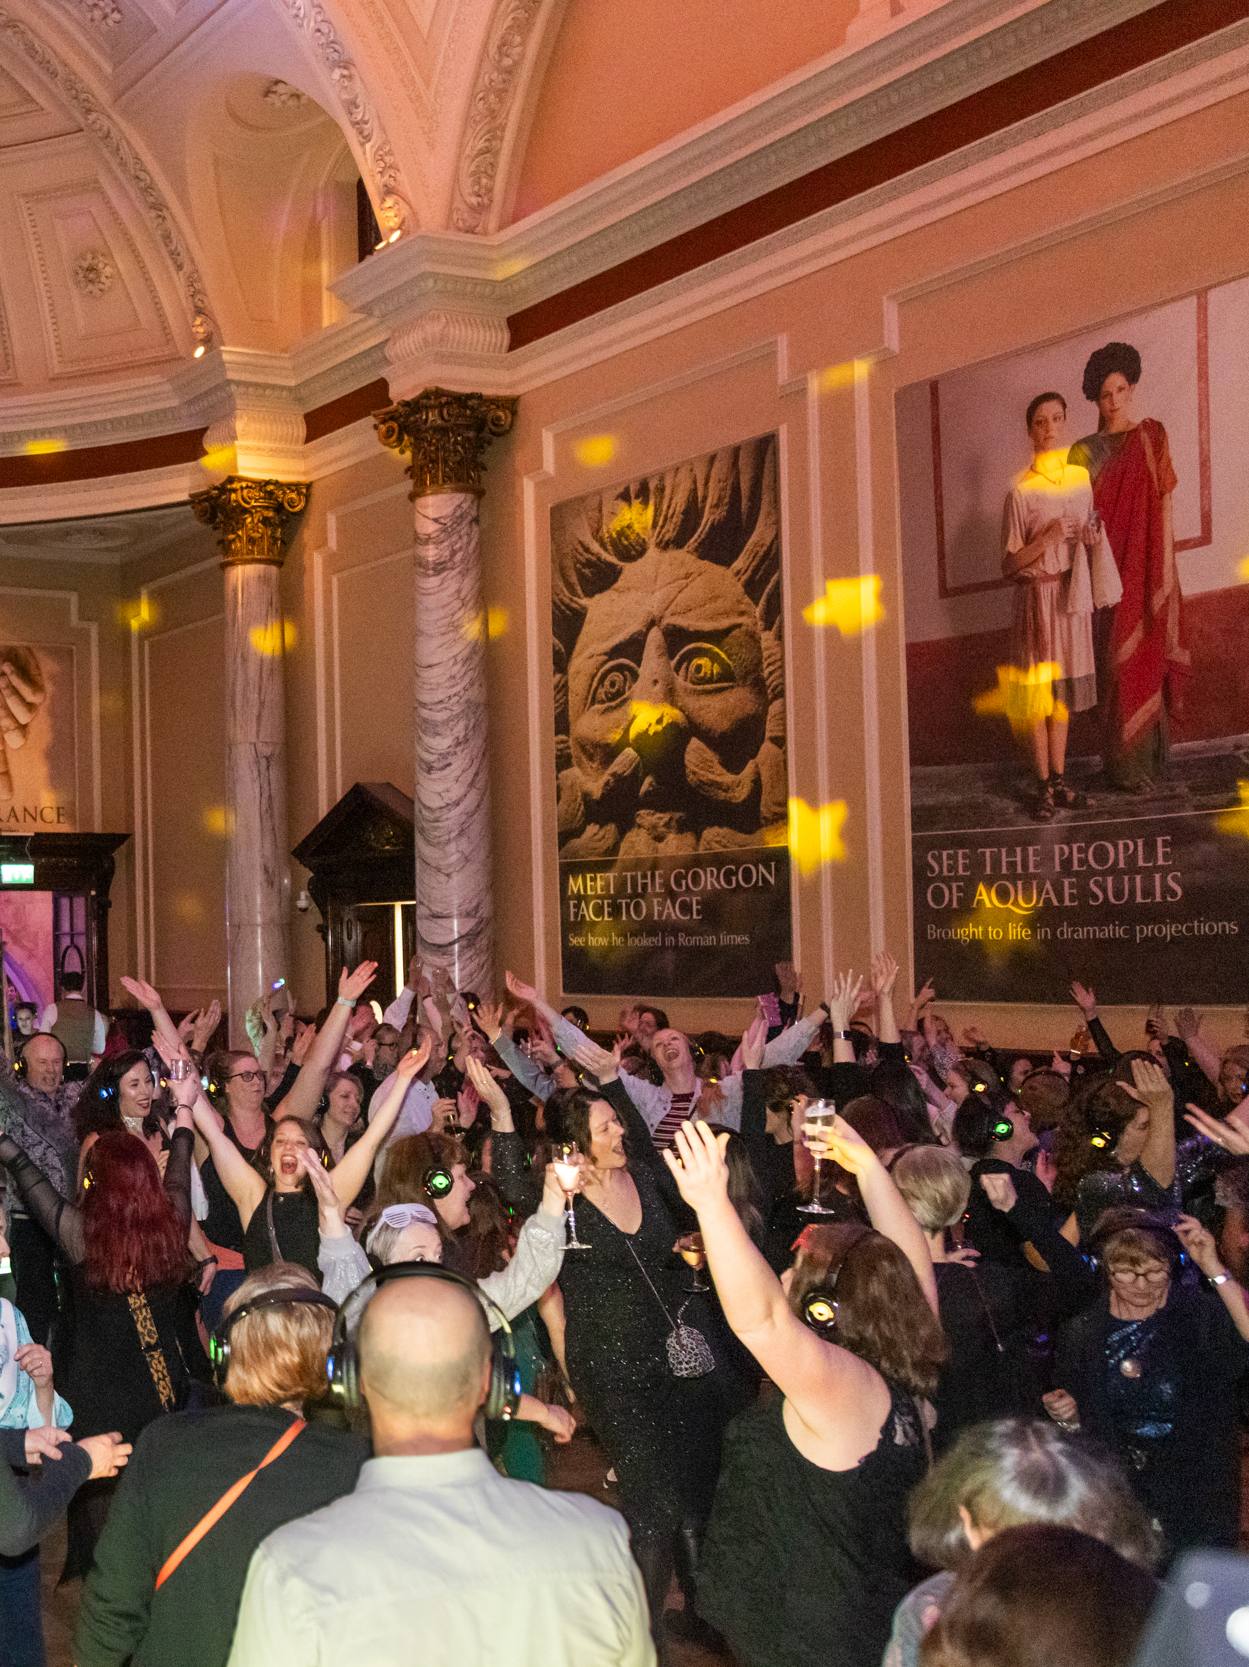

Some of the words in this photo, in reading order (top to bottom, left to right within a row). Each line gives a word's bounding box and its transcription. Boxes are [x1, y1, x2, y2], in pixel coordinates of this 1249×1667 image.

[927, 849, 971, 877] SEE
[977, 845, 1042, 875] THE
[1053, 836, 1173, 872] PEOPLE
[568, 872, 619, 896] MEET
[622, 870, 665, 893] THE
[670, 861, 776, 893] GORGON
[927, 882, 965, 909] OF
[973, 878, 1078, 915] AQUAE
[1089, 871, 1183, 906] SULIS
[569, 899, 613, 922] FACE
[617, 898, 646, 921] TO
[653, 896, 703, 921] FACE
[568, 933, 586, 947] See
[588, 933, 611, 947] how
[611, 932, 625, 947] he
[627, 932, 662, 947] looked
[665, 932, 675, 947] in
[678, 932, 716, 947] Roman
[720, 931, 750, 946] times
[927, 922, 983, 945] Brought
[988, 925, 1003, 940] to
[1008, 922, 1032, 940] life
[1037, 924, 1051, 940] in
[1057, 922, 1130, 940] dramatic
[1136, 917, 1239, 943] projections
